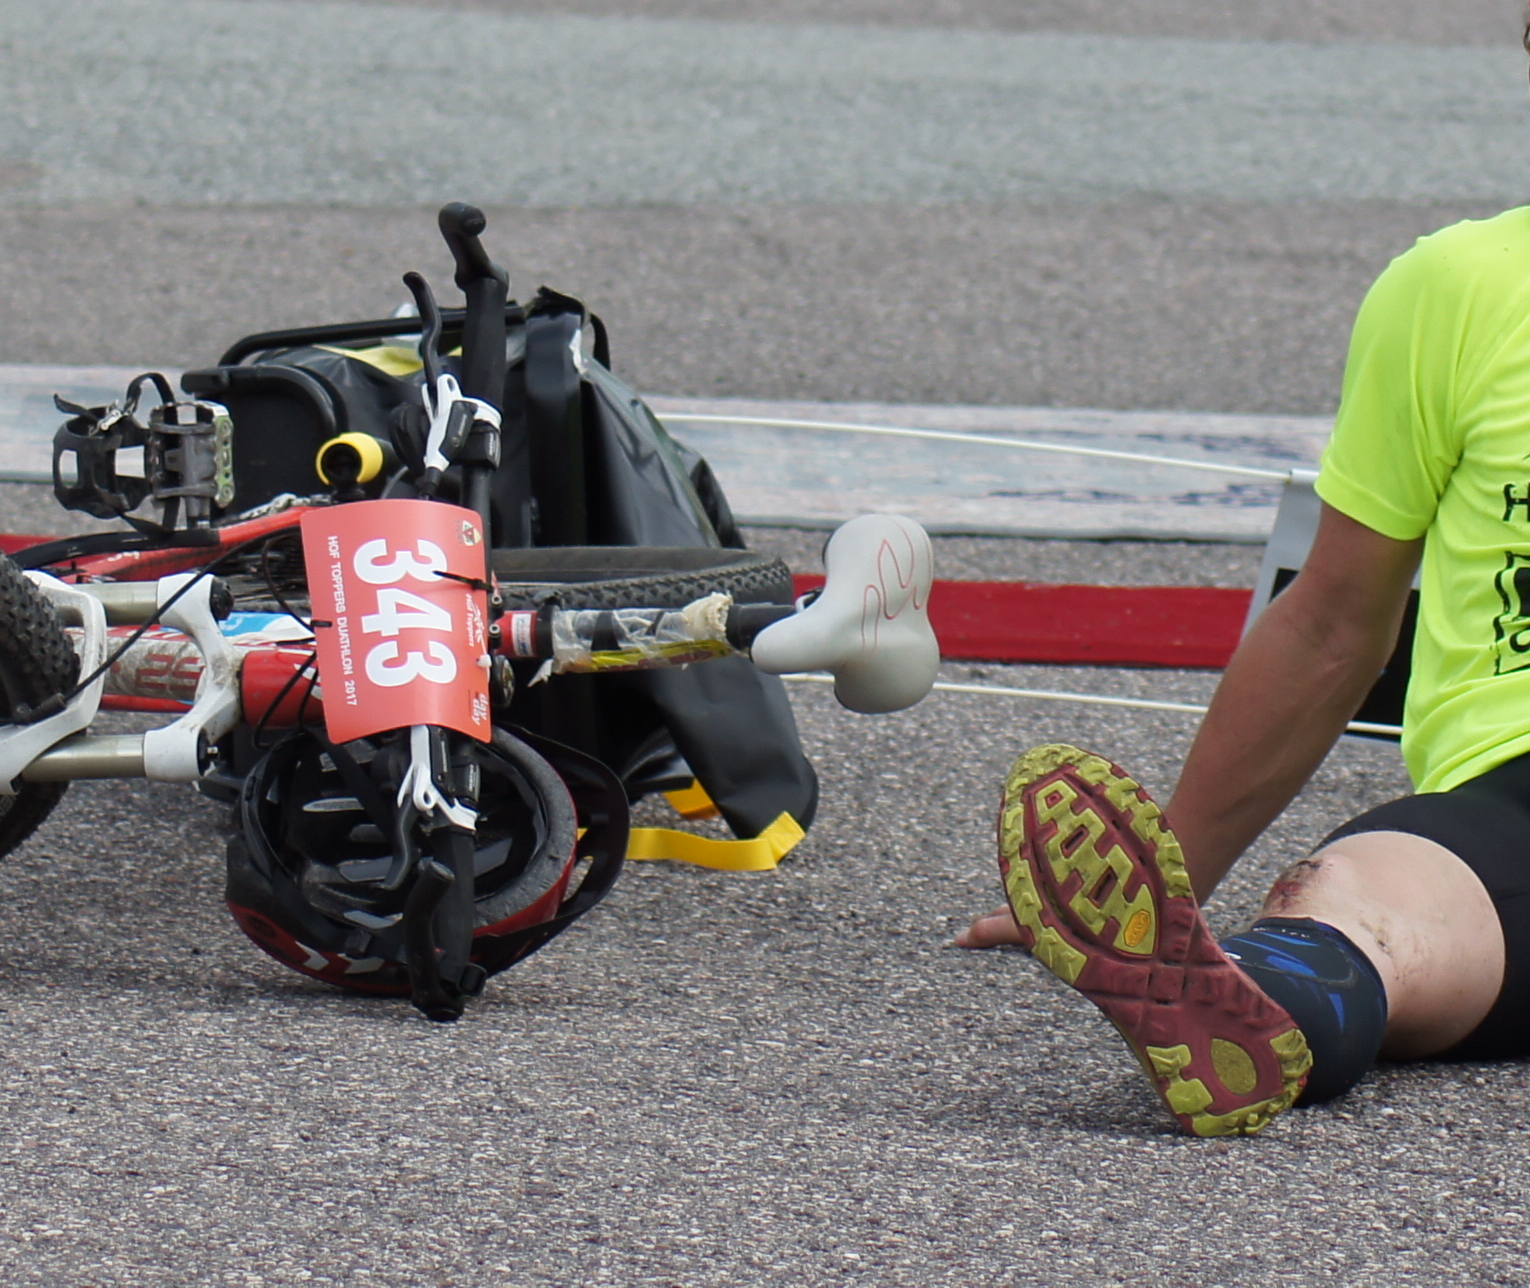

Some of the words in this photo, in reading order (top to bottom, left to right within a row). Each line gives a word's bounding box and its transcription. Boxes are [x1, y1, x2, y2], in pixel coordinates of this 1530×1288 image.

[327, 535, 339, 561] HOF
[330, 561, 347, 614] TOPPERS
[353, 538, 458, 688] 343
[337, 616, 354, 676] DUATHLON
[346, 680, 358, 707] 2017
